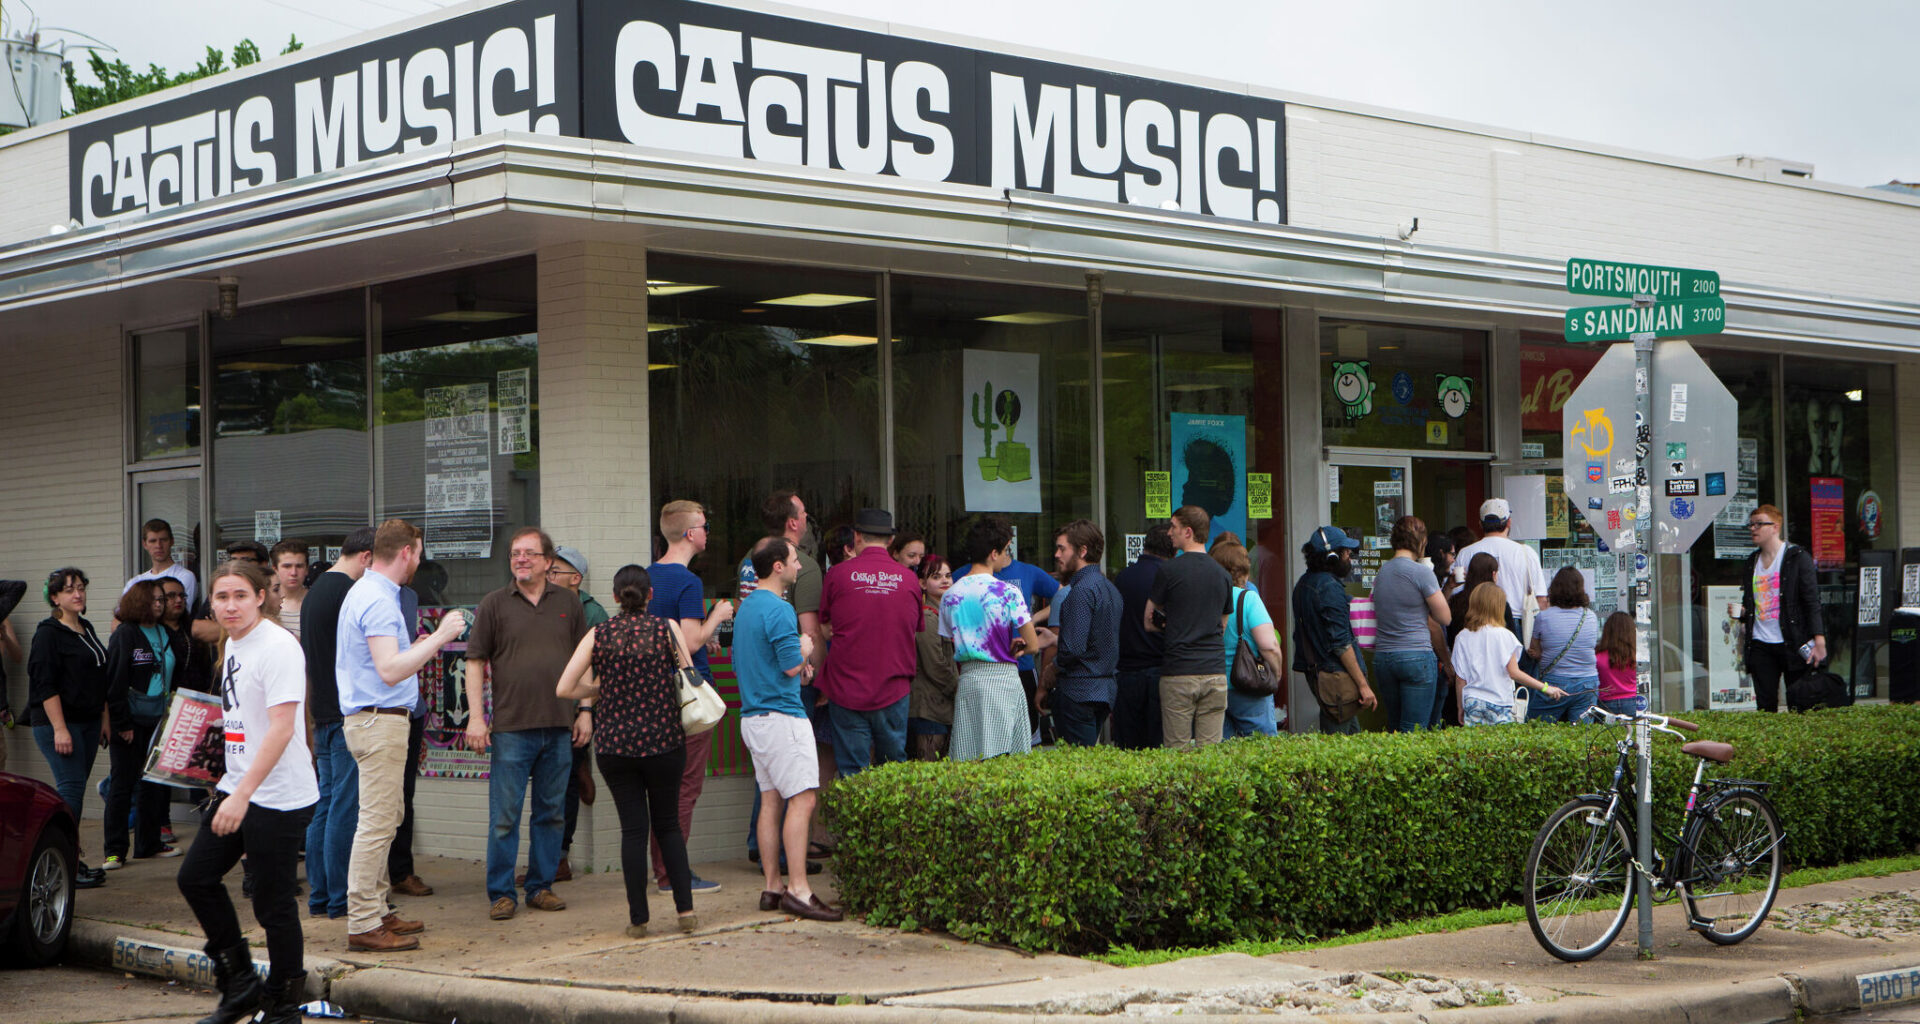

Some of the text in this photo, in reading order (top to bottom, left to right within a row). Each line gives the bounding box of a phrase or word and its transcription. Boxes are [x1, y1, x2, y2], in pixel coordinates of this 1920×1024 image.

[82, 14, 560, 226] CACTUS MUSIC!
[615, 20, 1281, 224] CACTUS MUSIC!
[1572, 262, 1716, 297] PORTSMOUTH 2100
[1570, 304, 1722, 336] S SANDMAN 3700
[1128, 536, 1141, 547] RSD
[851, 571, 876, 584] OSKAR
[1864, 568, 1877, 581] FREE
[1906, 565, 1918, 578] FREE
[1864, 582, 1877, 594] LIVE
[1906, 579, 1917, 591] LIVE
[1861, 595, 1880, 608] MUSIC
[1903, 592, 1920, 605] MUSIC
[1860, 609, 1880, 622] TODAY
[224, 720, 245, 730] ANDA
[160, 703, 197, 769] NEGATIVE
[174, 707, 208, 770] QUALITIES
[1861, 973, 1903, 1003] 2100
